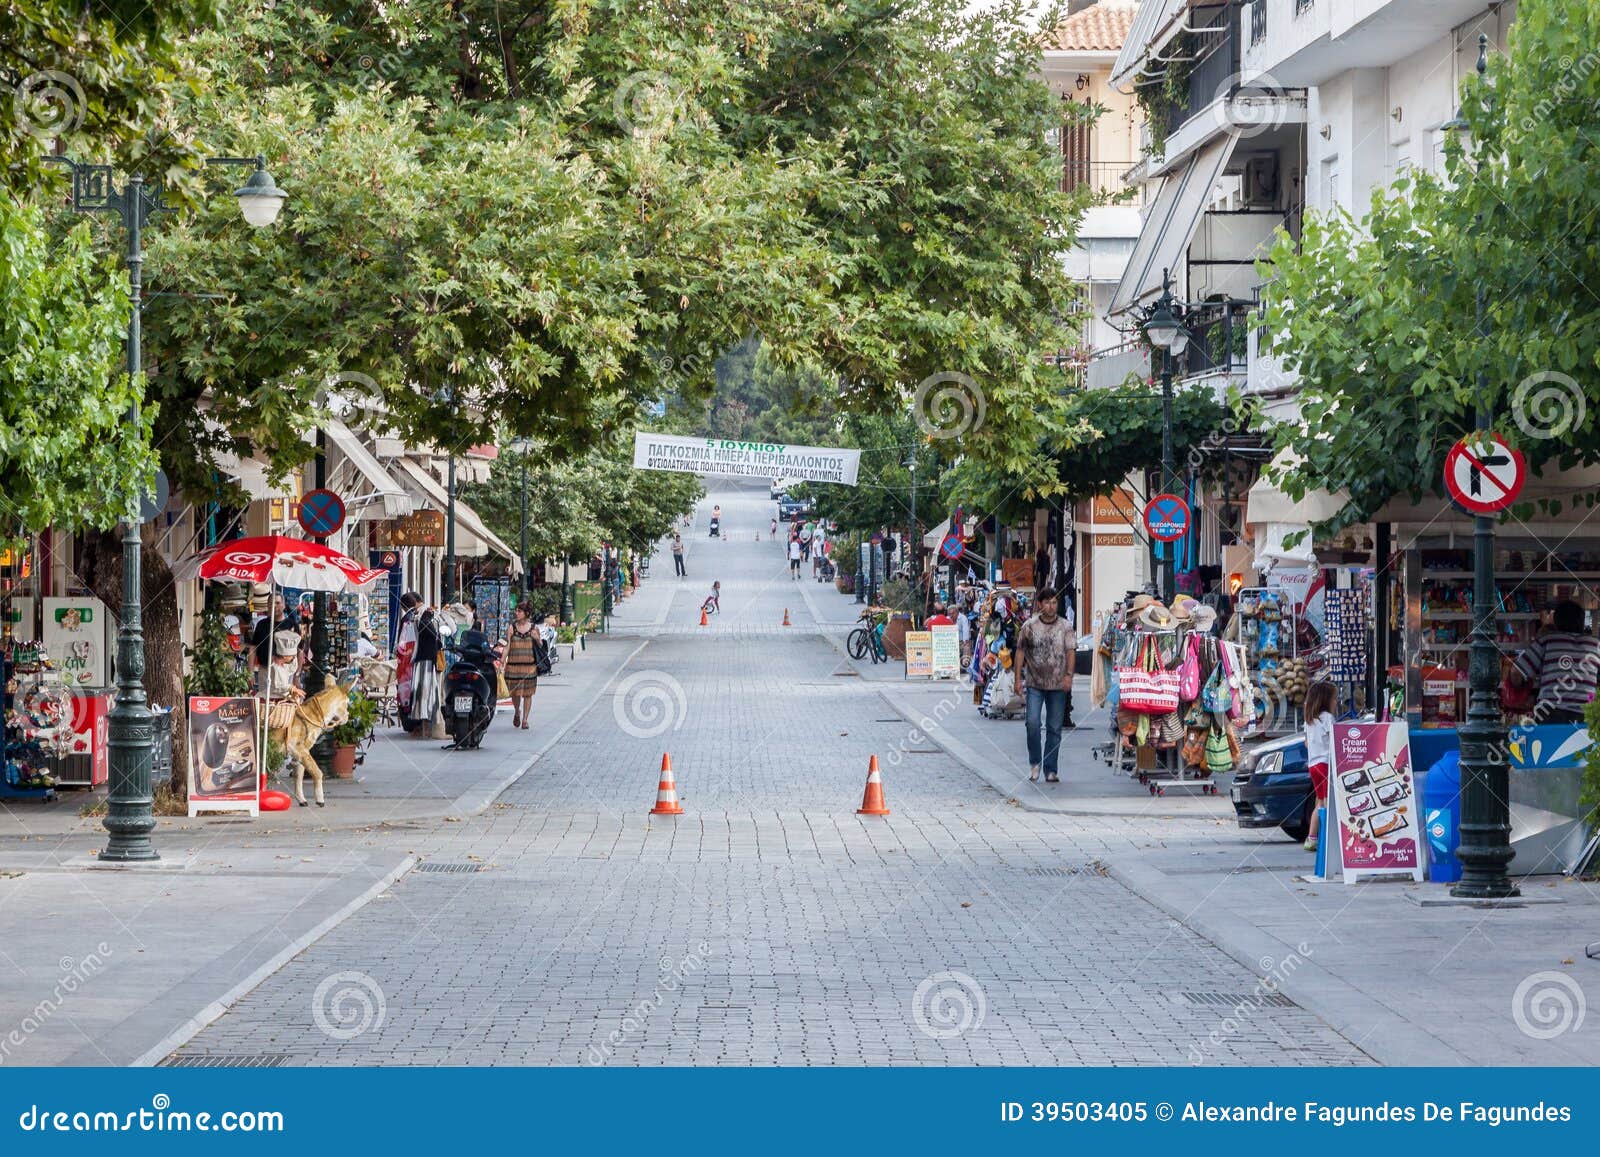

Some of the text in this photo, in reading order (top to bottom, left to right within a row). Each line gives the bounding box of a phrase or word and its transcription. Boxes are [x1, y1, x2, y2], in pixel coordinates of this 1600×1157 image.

[706, 439, 786, 453] 5 ΙΟΥΝΙΟΥ
[648, 444, 844, 470] ΠΑΓΚΟΣΜΙΑ ΗΜΕΡΑ ΠΕΡΙΒΑΛΛΟΝΤΟΣ
[647, 458, 842, 482] ΦΥΣΙΟΛΑΤΡΙΚΟΣ ΠΟΛΙΤΙΣΤΙΚΟΣ ΣΥΛΛΟΓΟΣ ΑΡΧΑΙΑΣ ΟΛΥΜΠΙΑΣ
[1341, 737, 1367, 746] Cream
[1342, 744, 1368, 753] House
